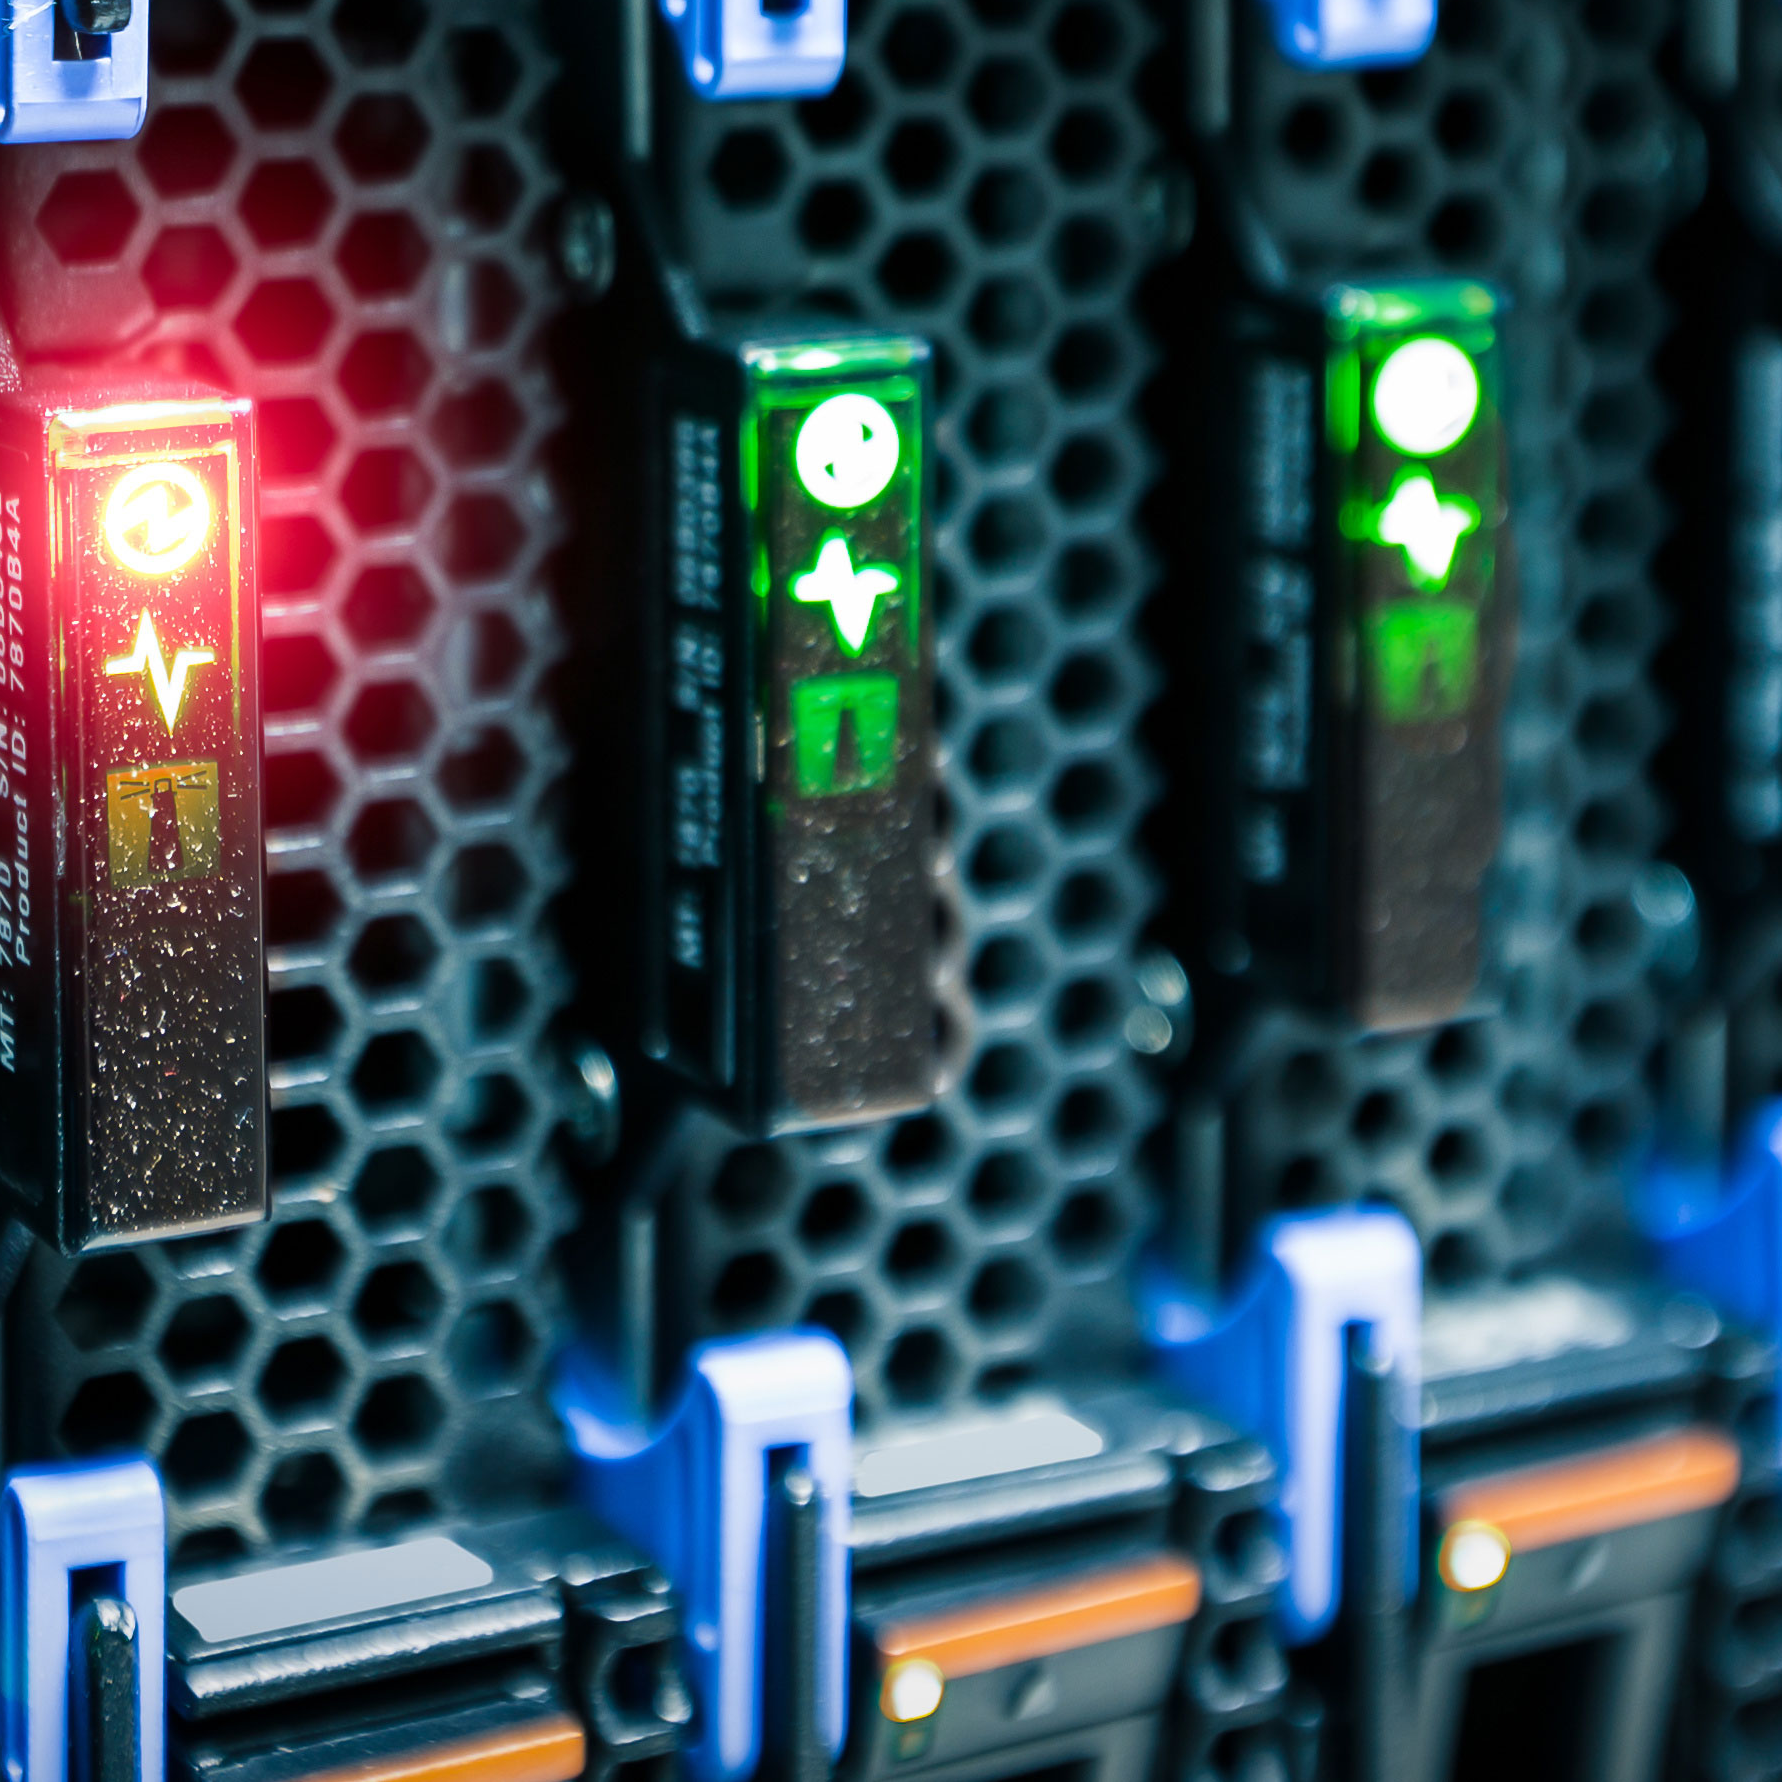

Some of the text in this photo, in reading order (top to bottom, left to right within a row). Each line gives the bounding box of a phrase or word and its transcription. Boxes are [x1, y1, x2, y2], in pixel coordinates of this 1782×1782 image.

[6, 496, 31, 966] Product ID: 7870B4A
